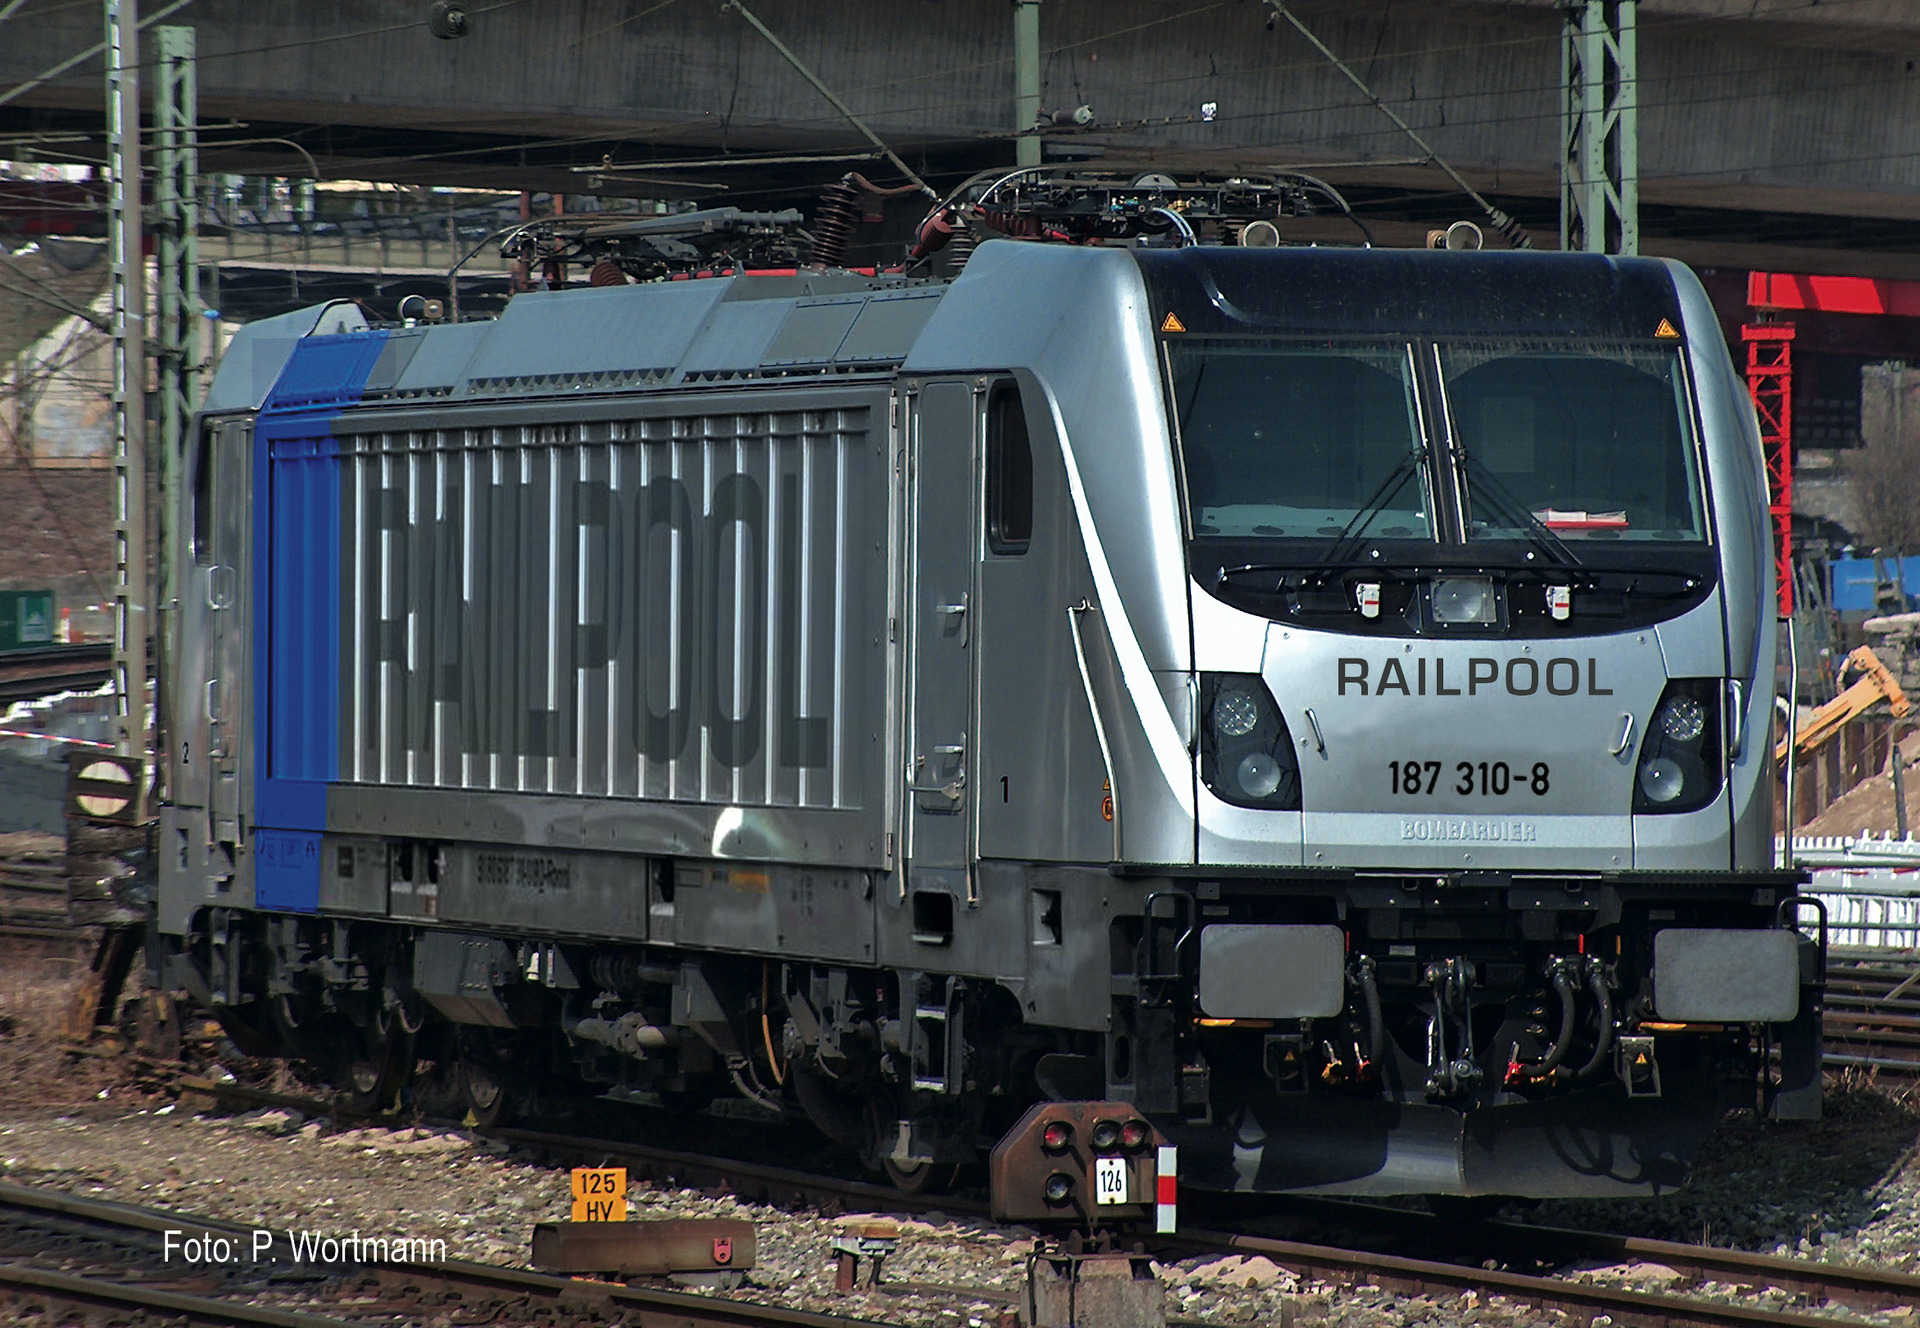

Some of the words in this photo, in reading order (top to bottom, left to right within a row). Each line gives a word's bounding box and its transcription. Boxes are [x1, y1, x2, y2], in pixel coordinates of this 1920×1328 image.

[367, 473, 828, 768] RAILPOOL
[1337, 657, 1614, 696] RAILPOOL
[1000, 775, 1009, 804] 1
[1388, 760, 1442, 795] 187
[1455, 761, 1550, 796] 310-8
[1400, 820, 1536, 842] BOMBARDIER
[581, 1173, 616, 1194] 125
[1101, 1169, 1122, 1193] 126
[587, 1200, 614, 1221] HV
